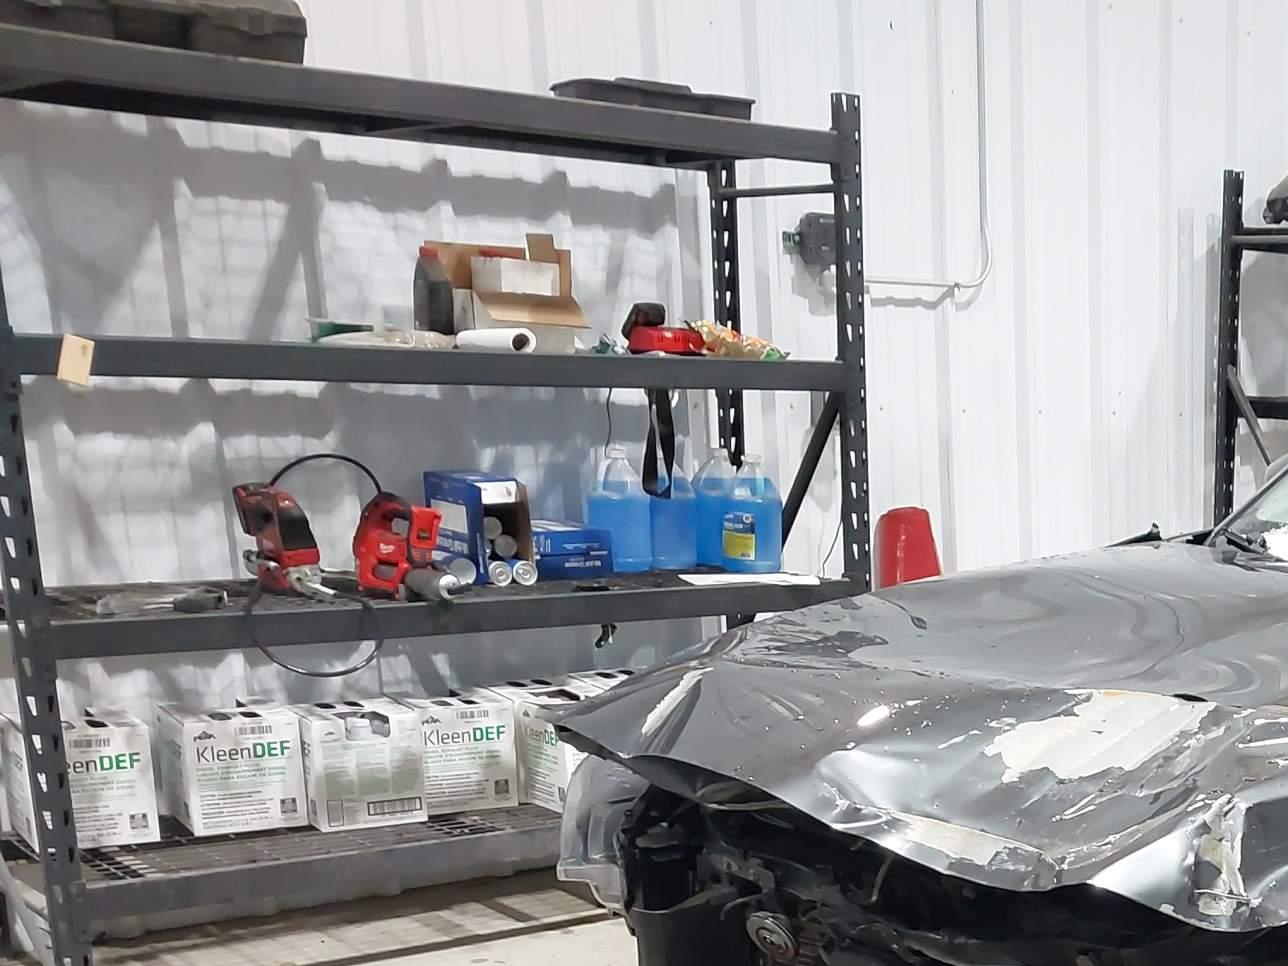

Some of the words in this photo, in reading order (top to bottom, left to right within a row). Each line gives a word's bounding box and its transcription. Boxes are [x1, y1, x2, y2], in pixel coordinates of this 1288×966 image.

[423, 724, 506, 747] KleenDEF
[65, 751, 141, 775] eenDEF
[196, 740, 291, 763] KleenDEF
